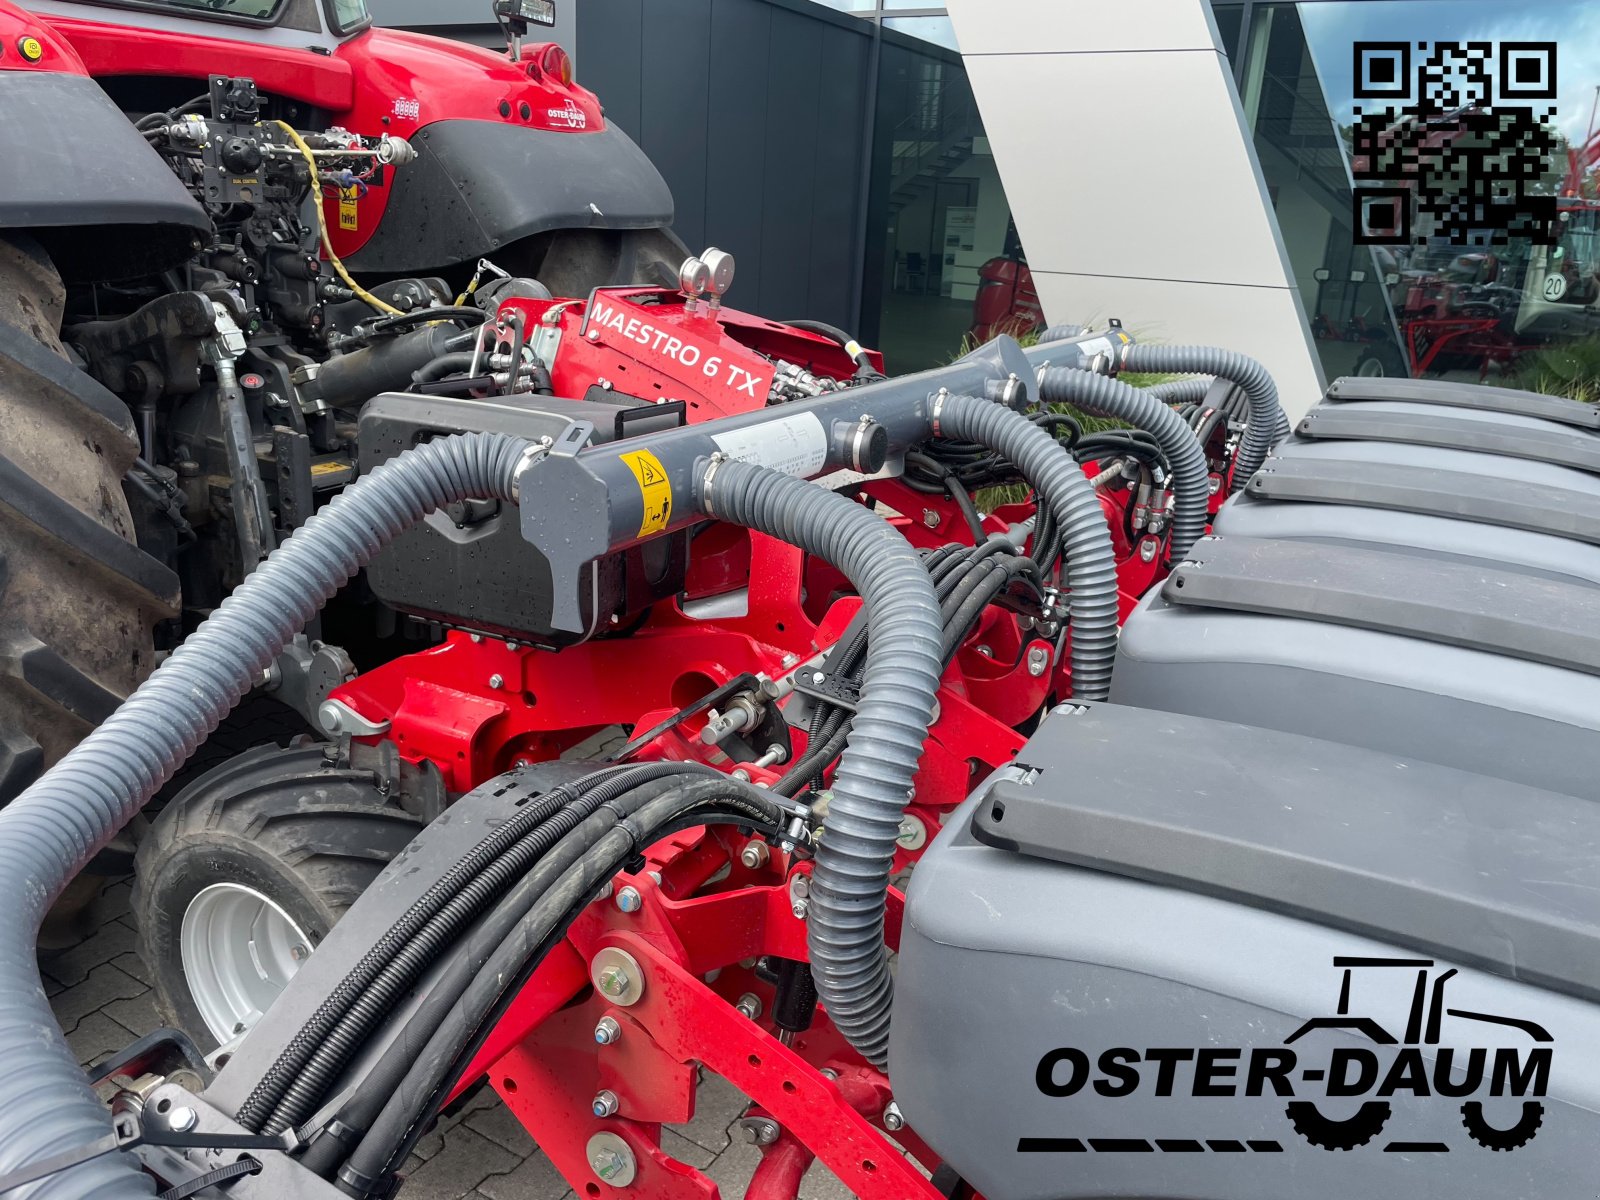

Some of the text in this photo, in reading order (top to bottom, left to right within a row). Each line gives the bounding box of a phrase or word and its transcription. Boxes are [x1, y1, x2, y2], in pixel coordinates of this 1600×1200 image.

[1546, 278, 1561, 294] 20
[590, 302, 763, 398] MAESTRO 6 TX
